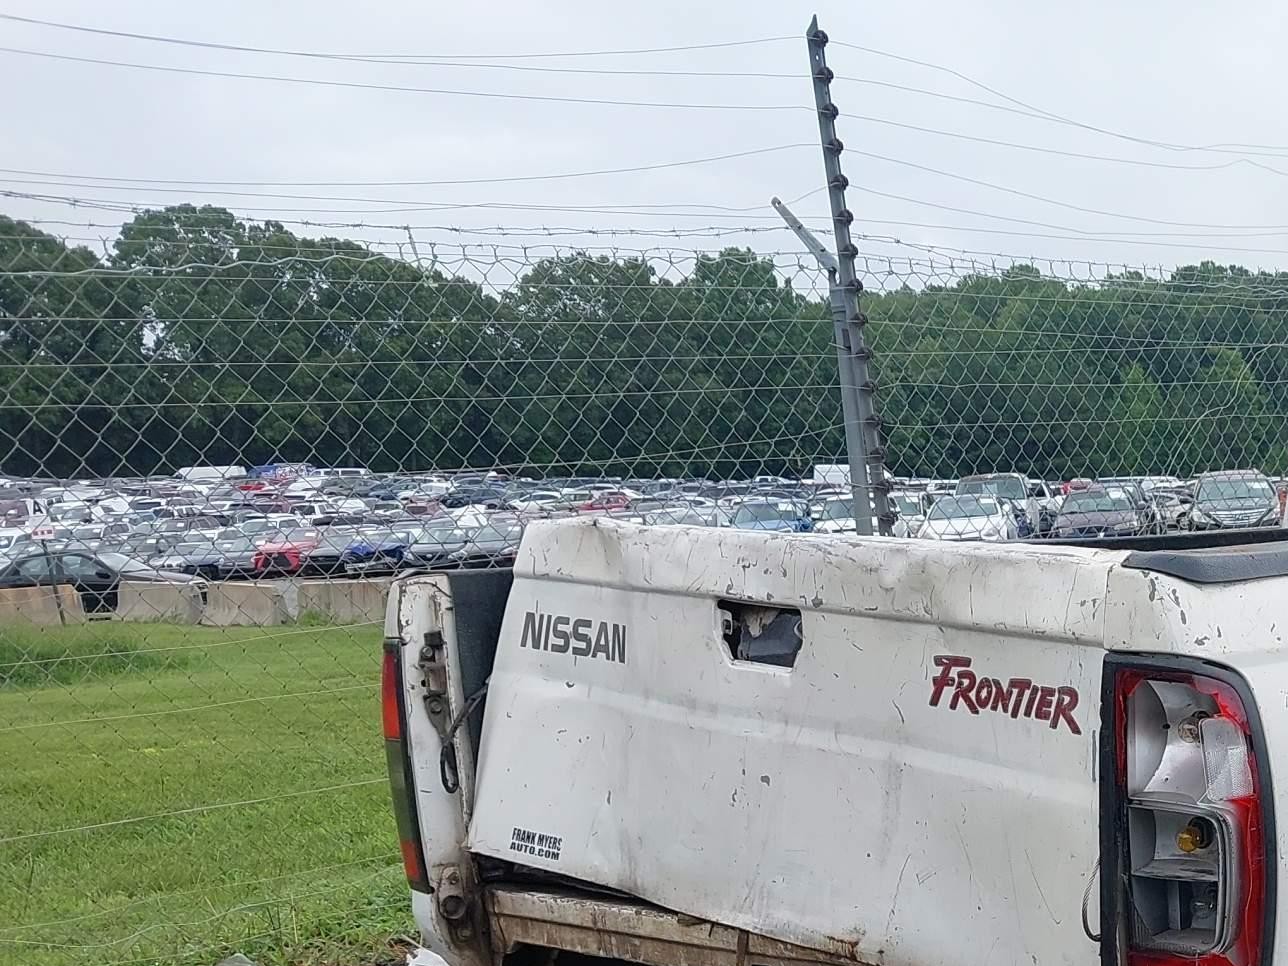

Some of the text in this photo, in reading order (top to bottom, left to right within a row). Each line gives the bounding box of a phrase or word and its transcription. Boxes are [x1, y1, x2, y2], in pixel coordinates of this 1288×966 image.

[520, 611, 626, 664] NISSAN
[509, 841, 560, 861] AUTO.COM
[511, 827, 563, 851] FRANK MYERS
